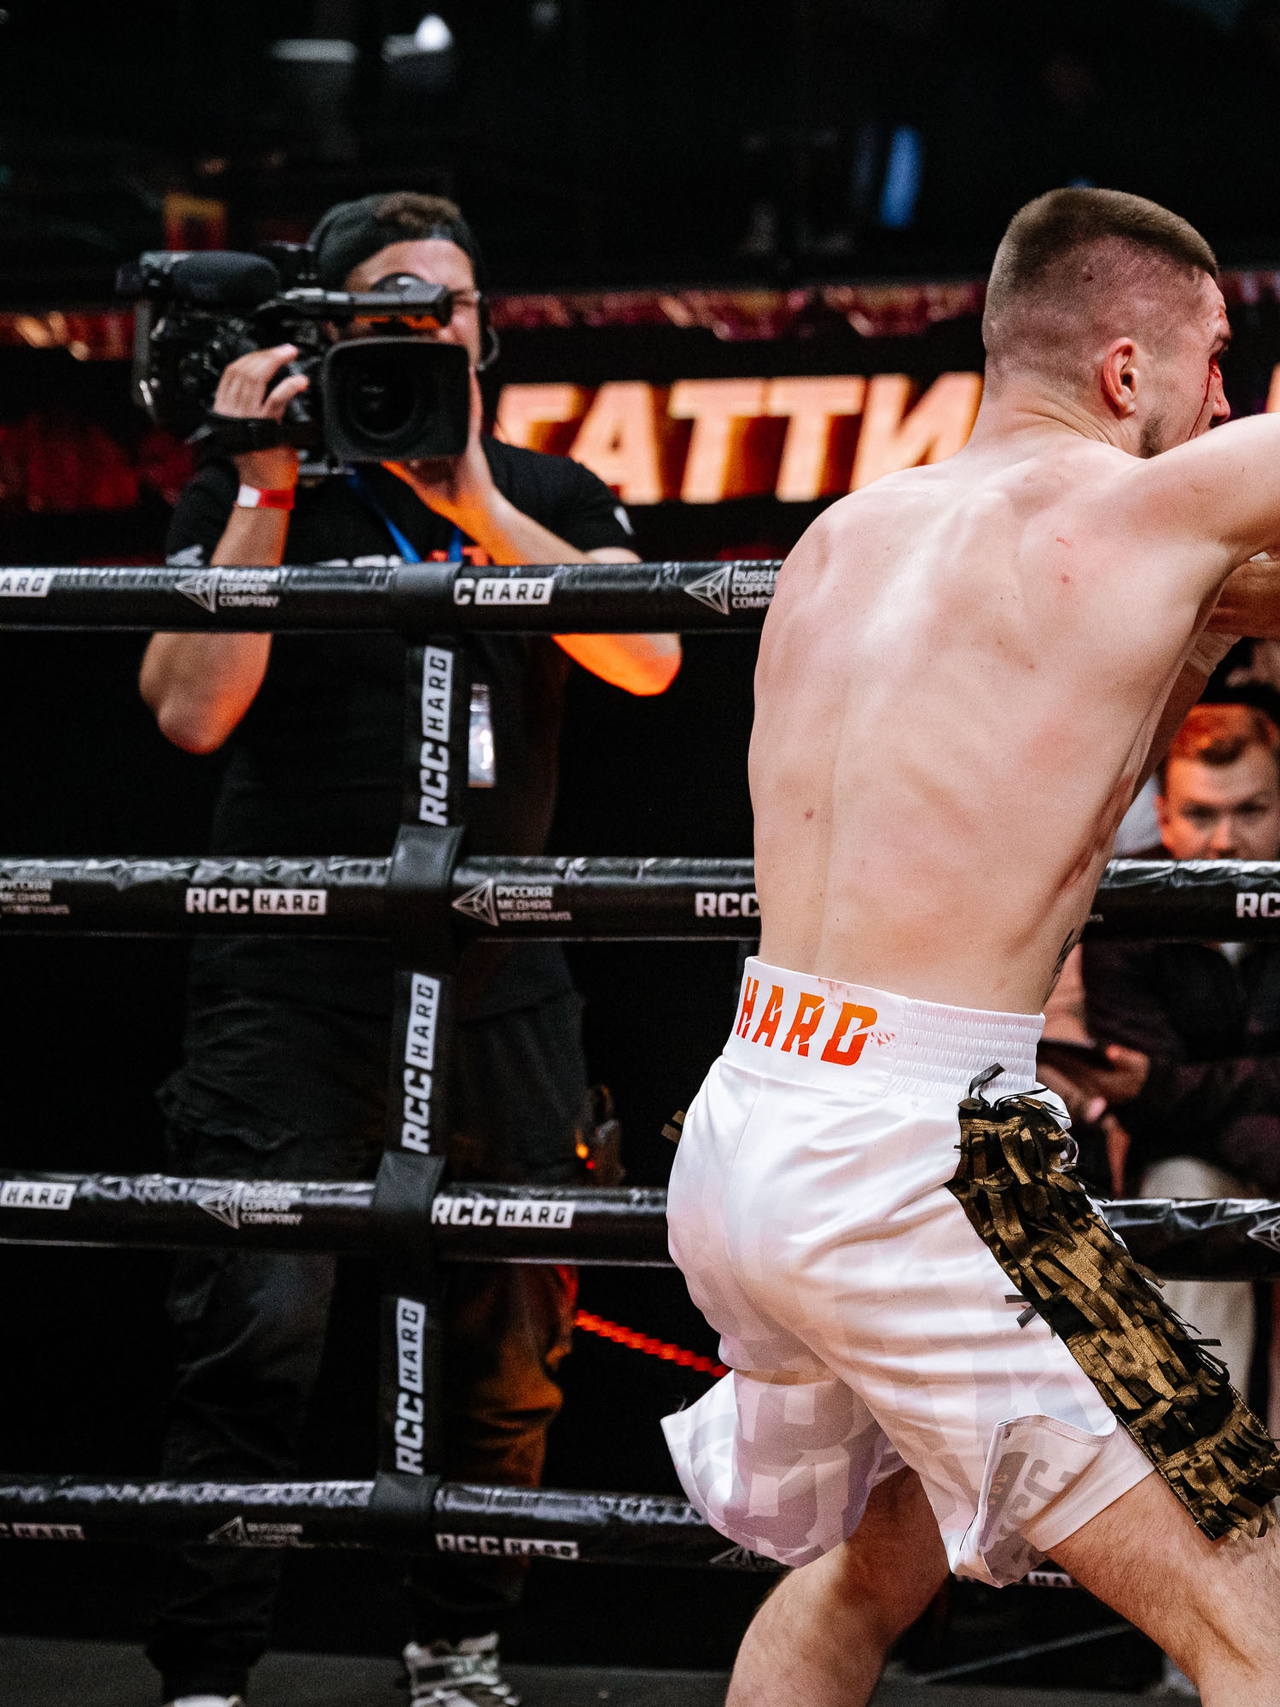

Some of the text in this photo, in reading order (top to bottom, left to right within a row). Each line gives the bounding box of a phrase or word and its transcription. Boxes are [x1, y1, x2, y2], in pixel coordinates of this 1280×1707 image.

[0, 573, 47, 594] ARD
[732, 568, 780, 581] RUSSI
[480, 581, 547, 602] HARD
[731, 582, 776, 595] COPPE
[731, 596, 772, 609] COMP
[419, 653, 450, 827] RCC HARD
[186, 888, 323, 914] RCC HARD
[695, 892, 761, 918] RCC
[735, 975, 878, 1067] HARD
[401, 981, 436, 1155] RCC HARD
[5, 1184, 67, 1206] HARD
[431, 1198, 571, 1226] RCC HARD
[395, 1305, 424, 1476] RCC HARD
